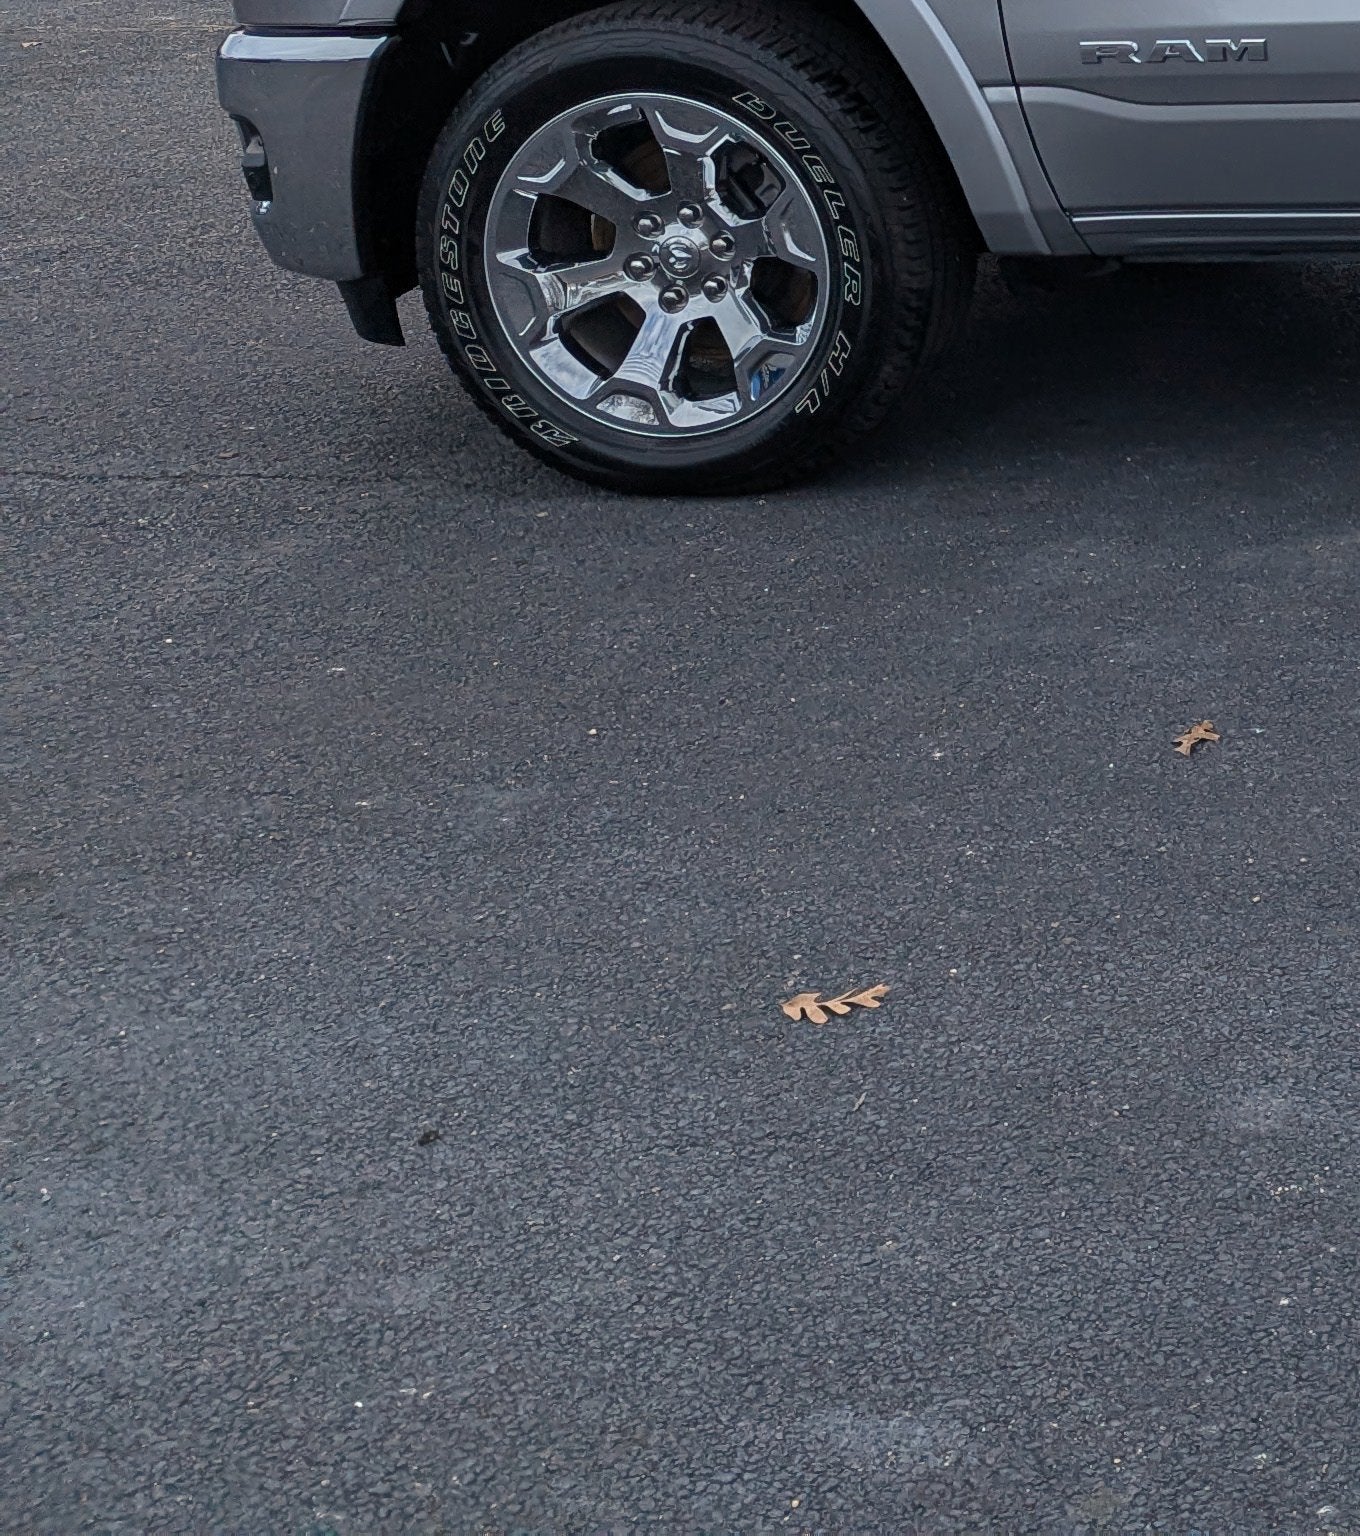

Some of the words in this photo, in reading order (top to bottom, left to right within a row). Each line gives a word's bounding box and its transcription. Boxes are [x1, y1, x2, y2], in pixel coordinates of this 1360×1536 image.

[1079, 38, 1269, 65] RAM
[438, 109, 580, 447] BRIDGESTONE
[732, 92, 862, 306] DUELER
